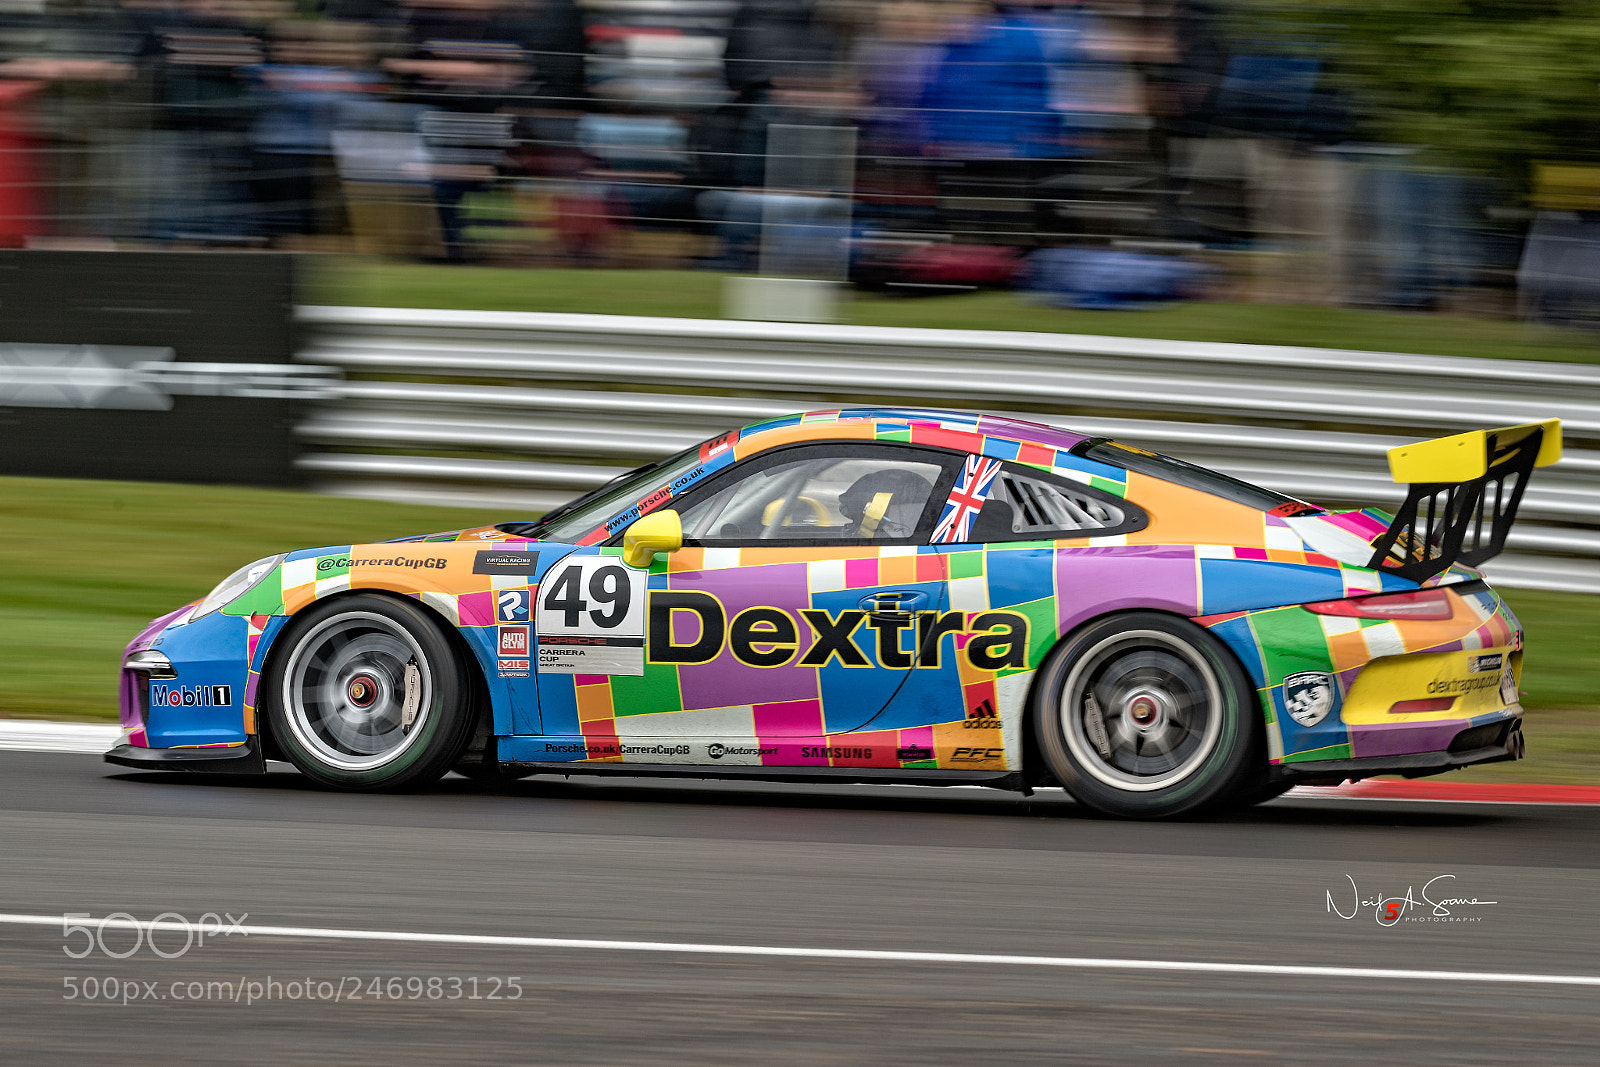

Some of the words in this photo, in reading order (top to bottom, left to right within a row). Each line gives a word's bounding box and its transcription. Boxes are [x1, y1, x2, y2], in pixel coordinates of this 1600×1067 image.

[604, 466, 705, 533] www.porsche.co.uk
[316, 556, 448, 571] @CarreraCupGB
[544, 565, 631, 629] 49
[646, 590, 1031, 670] Dextra
[502, 633, 525, 641] AUTO
[539, 637, 607, 645] PORSCHE
[502, 640, 525, 649] GLYM
[152, 684, 211, 708] Mobil
[212, 685, 231, 706] 1
[963, 717, 1003, 729] adidas
[545, 743, 690, 755] Porsche.co.uk/CarreraCupGB
[802, 747, 872, 758] SAMSUNG
[953, 748, 1004, 757] PFC
